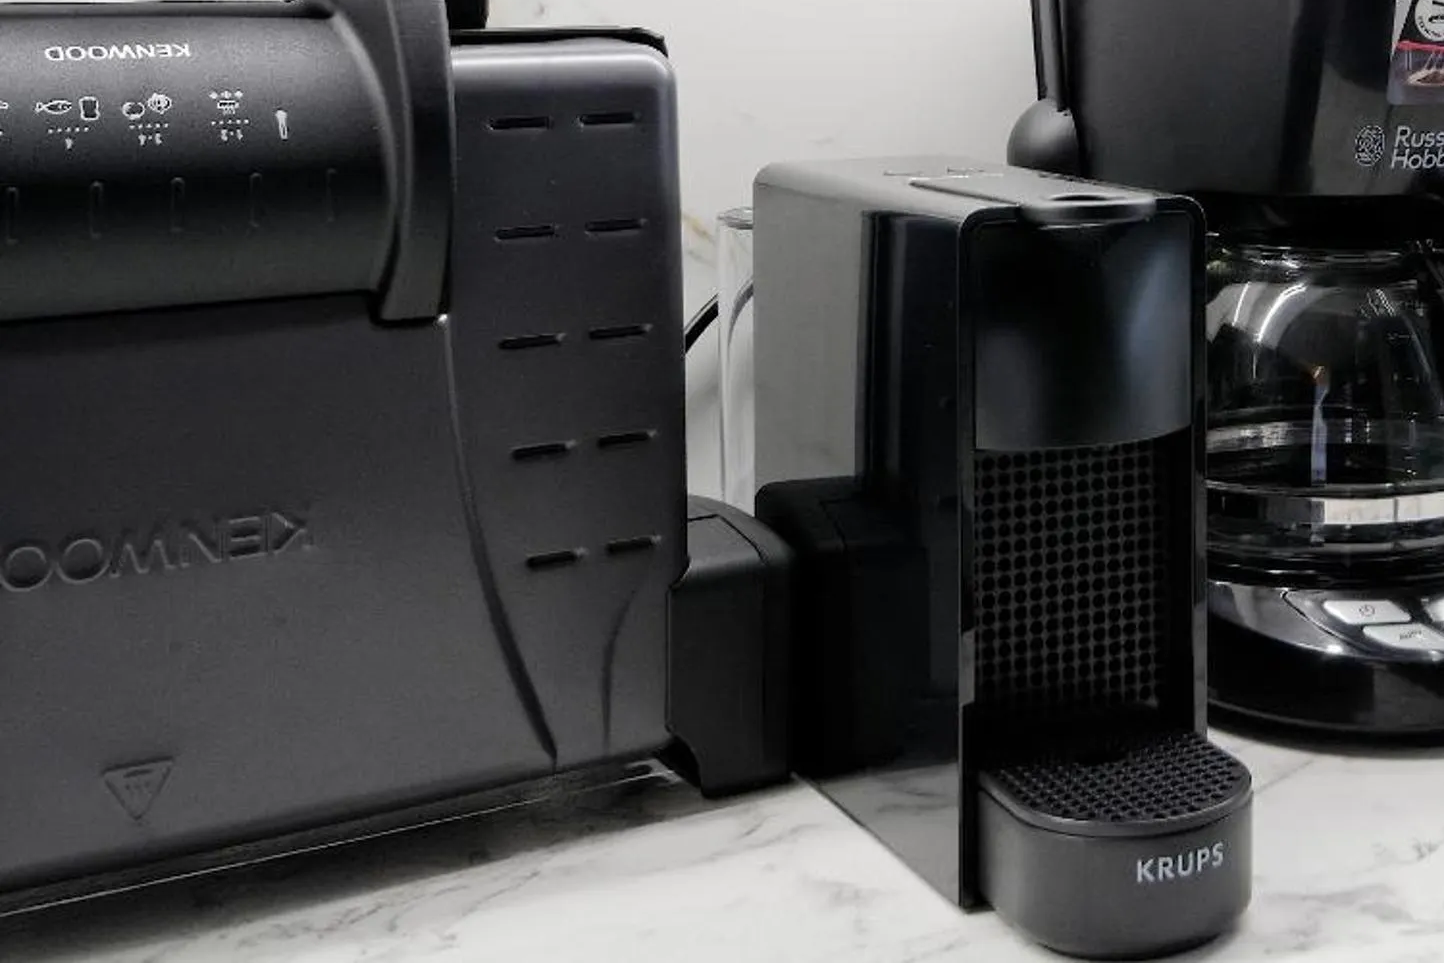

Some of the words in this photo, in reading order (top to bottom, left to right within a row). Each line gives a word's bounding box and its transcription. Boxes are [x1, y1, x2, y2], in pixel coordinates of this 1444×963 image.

[44, 44, 191, 61] KENWOOD
[0, 511, 306, 592] KENWOO
[1136, 842, 1224, 883] KRUPS
